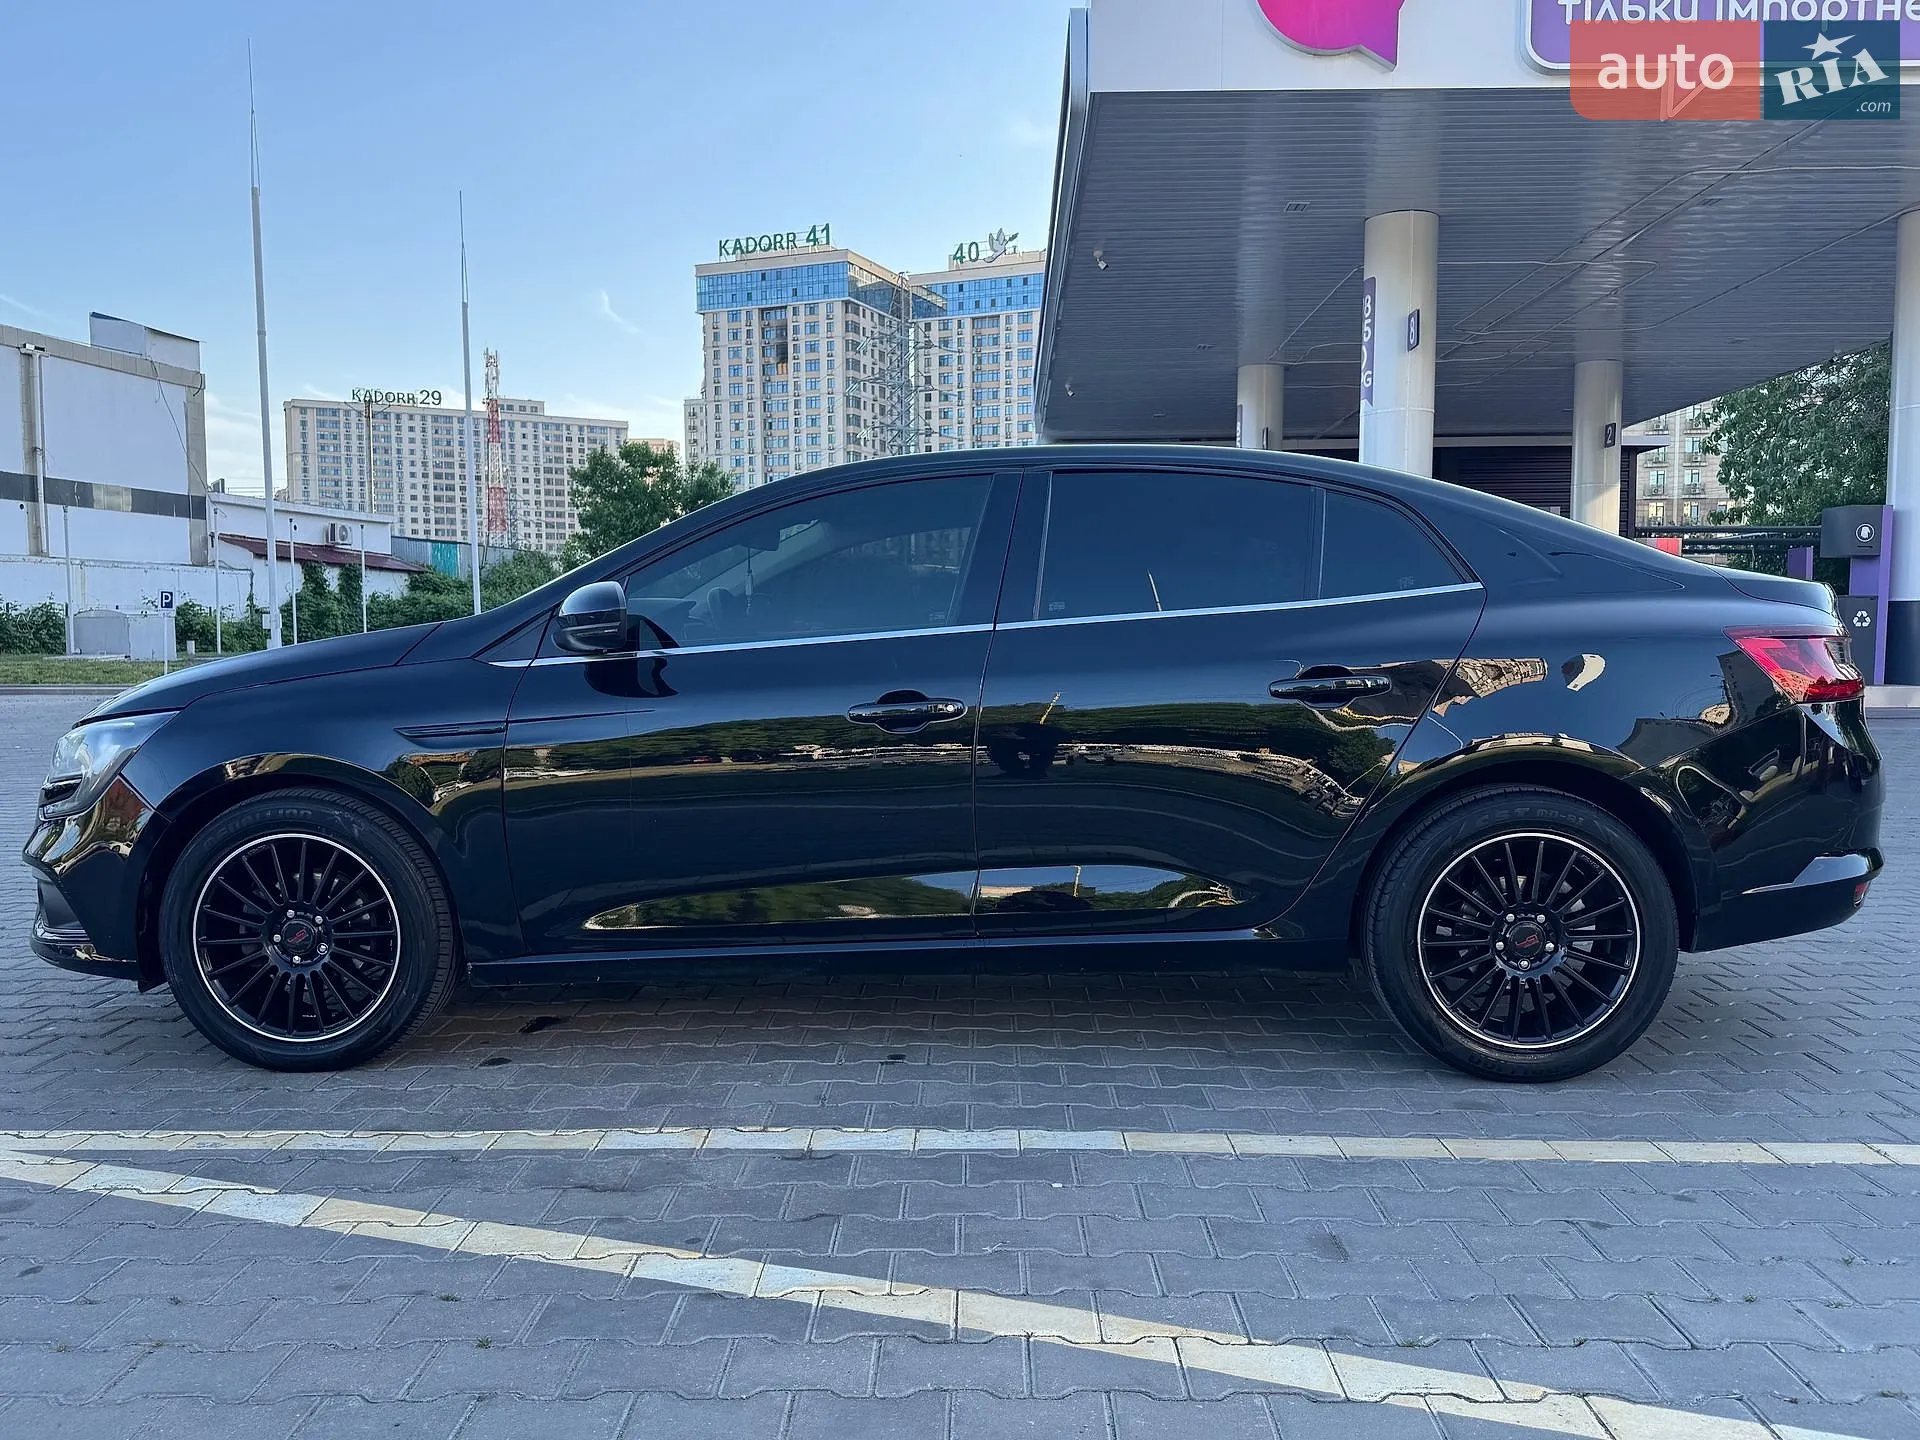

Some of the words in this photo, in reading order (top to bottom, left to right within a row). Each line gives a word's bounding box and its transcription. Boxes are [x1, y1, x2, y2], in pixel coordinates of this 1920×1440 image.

[719, 231, 798, 257] KADORR
[805, 222, 830, 247] 41
[952, 241, 980, 264] 40
[1409, 316, 1415, 345] 8
[351, 388, 417, 405] KADORR
[419, 389, 442, 406] 29
[1606, 426, 1613, 443] 2
[162, 592, 171, 607] P
